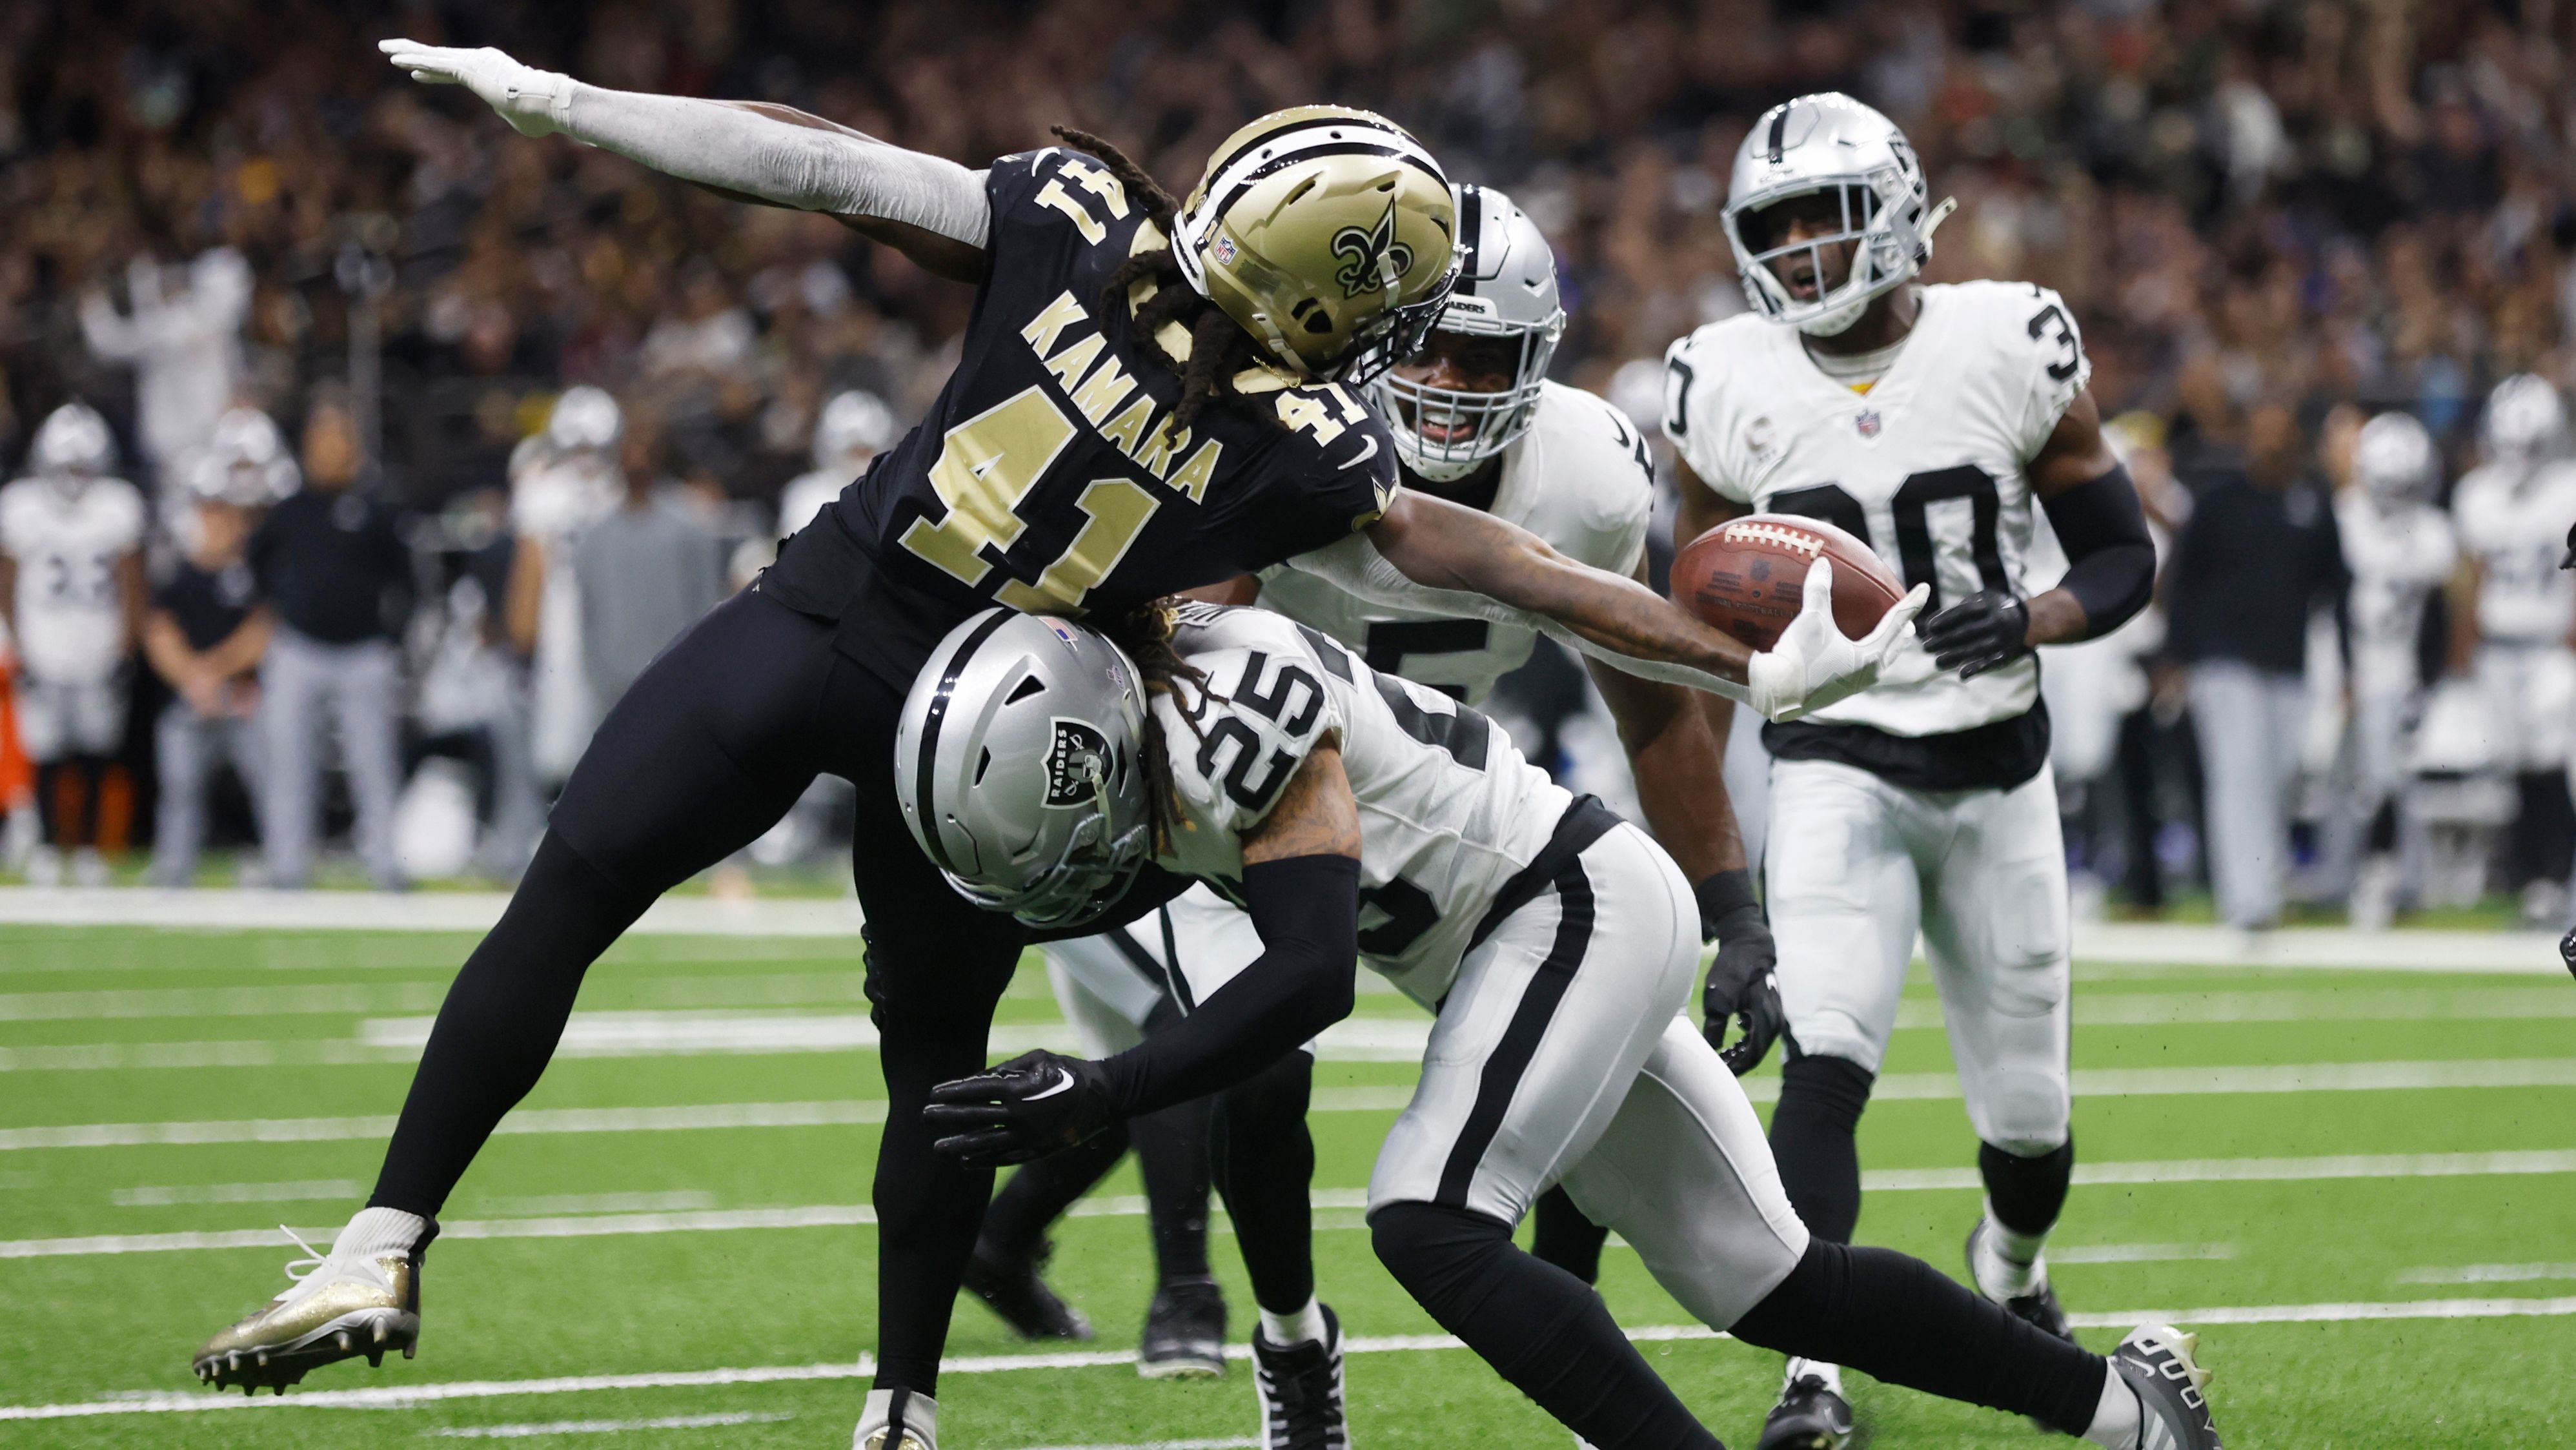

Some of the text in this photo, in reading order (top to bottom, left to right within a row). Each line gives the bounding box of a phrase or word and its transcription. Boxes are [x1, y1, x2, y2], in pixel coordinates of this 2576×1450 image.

[1033, 158, 1130, 247] 41
[1448, 301, 1486, 314] AIDERS
[1020, 289, 1223, 505] KAMARA
[1275, 382, 1369, 448] 41
[897, 383, 1162, 621] 41
[1050, 729, 1068, 798] RAIDERS
[1195, 649, 1325, 813] 25
